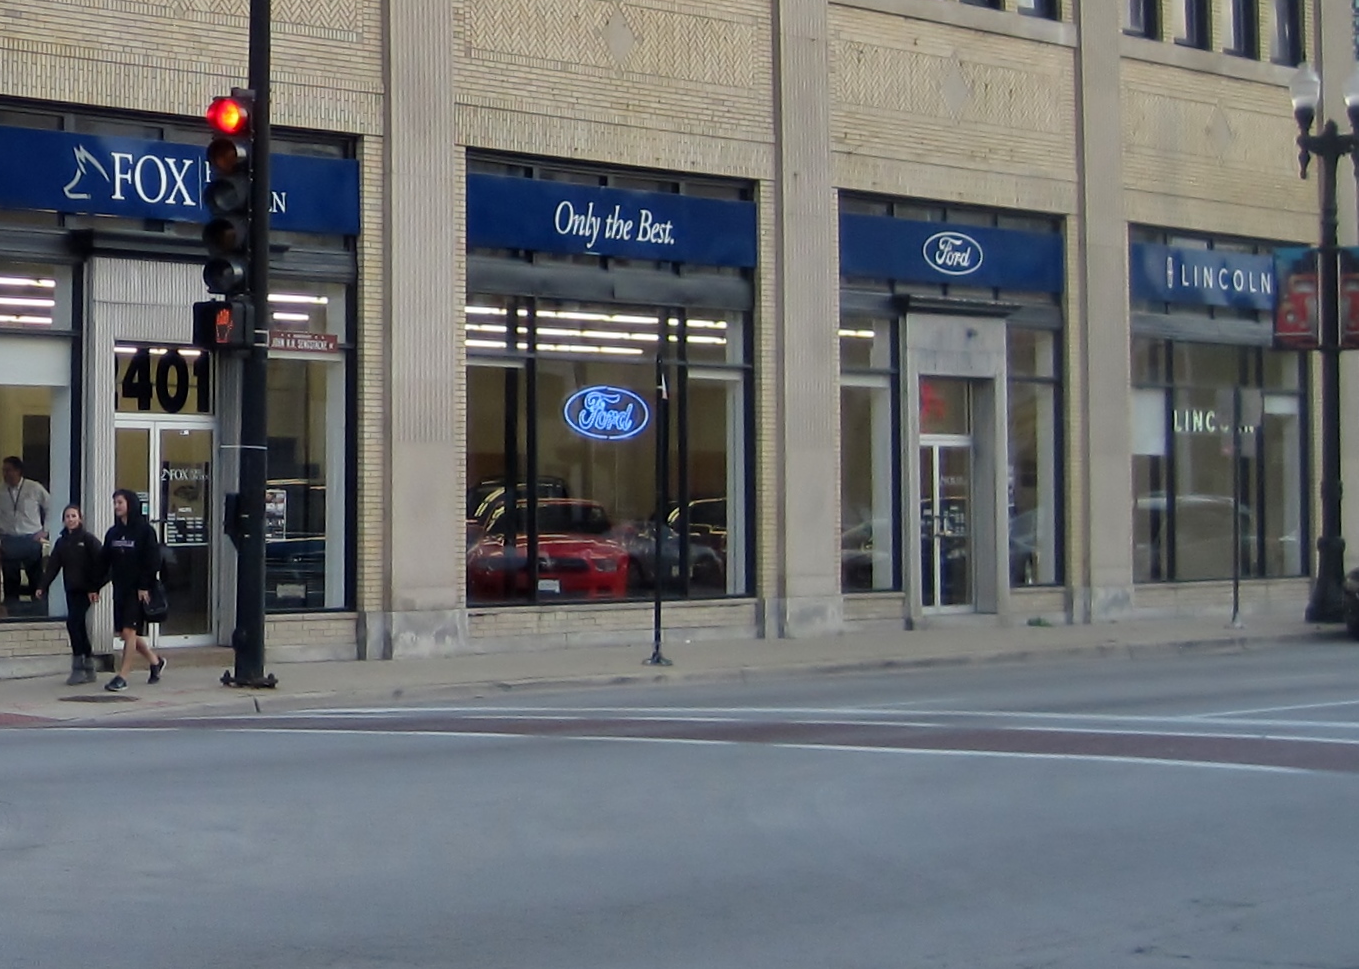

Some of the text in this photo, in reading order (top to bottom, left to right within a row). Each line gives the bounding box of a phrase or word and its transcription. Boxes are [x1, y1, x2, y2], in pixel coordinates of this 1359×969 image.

[111, 152, 197, 207] FOX
[554, 200, 675, 249] Only the Best.
[935, 236, 972, 267] Ford
[1180, 263, 1272, 295] LINCOLN
[578, 391, 634, 431] Ford
[1173, 409, 1255, 433] LINC
[170, 468, 189, 481] FOX
